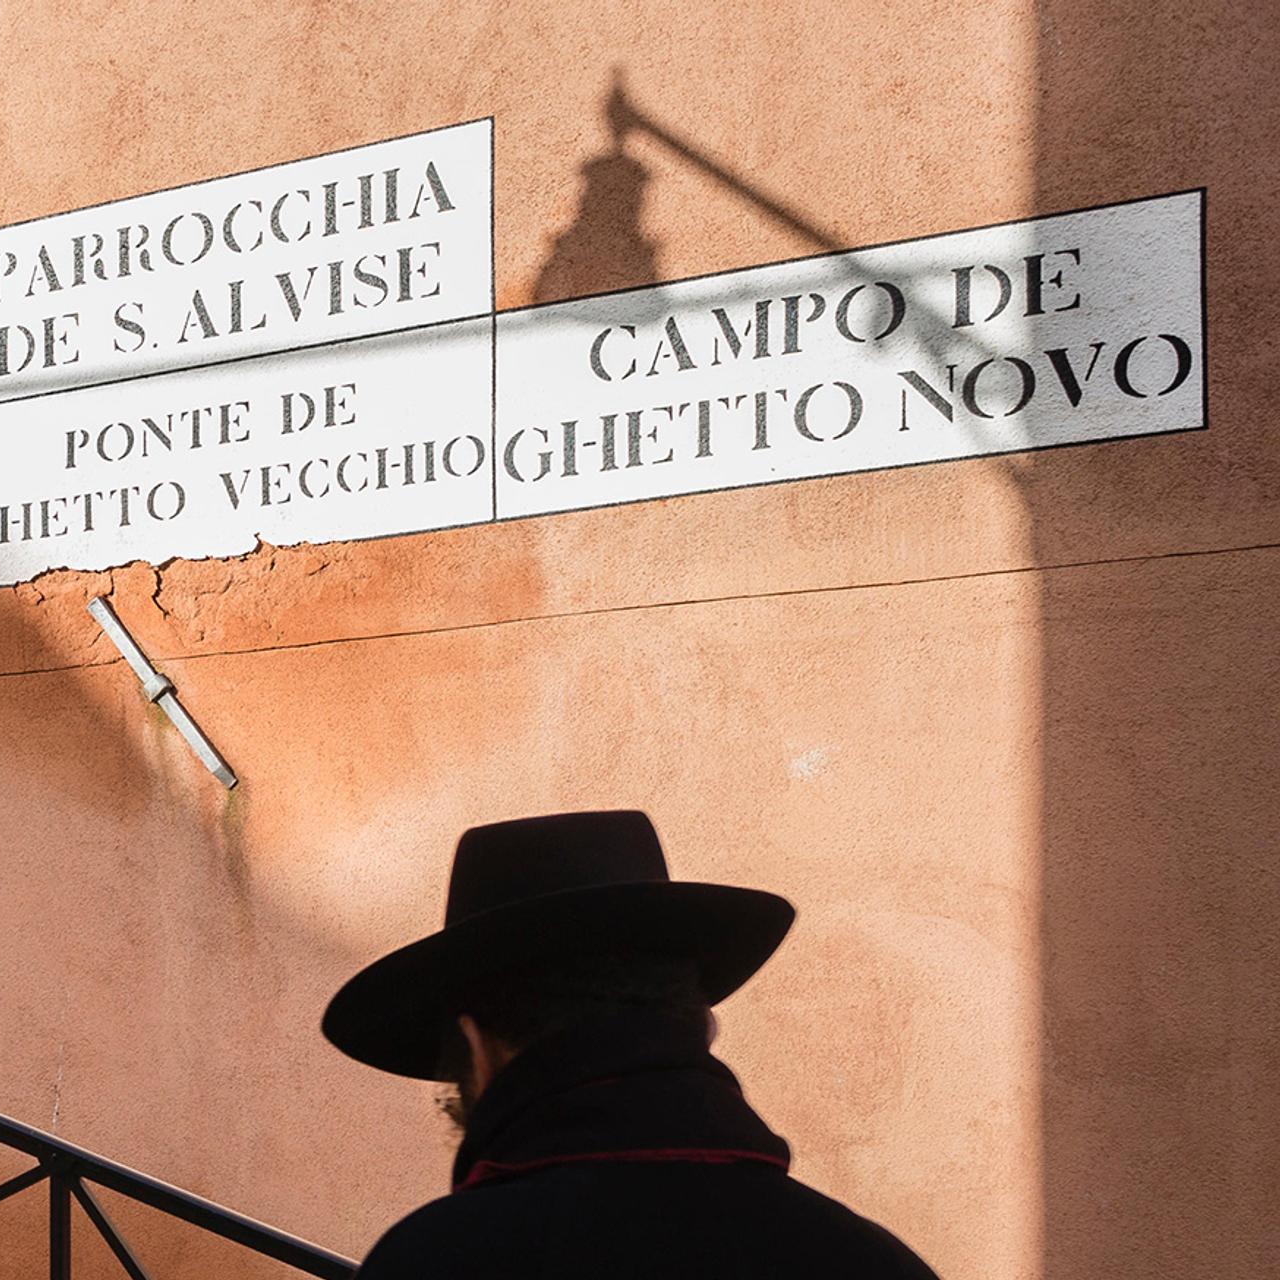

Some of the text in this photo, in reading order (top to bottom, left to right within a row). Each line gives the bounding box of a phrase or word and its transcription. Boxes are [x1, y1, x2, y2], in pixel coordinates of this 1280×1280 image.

[590, 248, 1081, 381] CAMPO DE
[64, 383, 357, 470] PONTE DE
[503, 333, 1192, 483] GHETTO NOVO
[218, 434, 486, 512] VECCHIO
